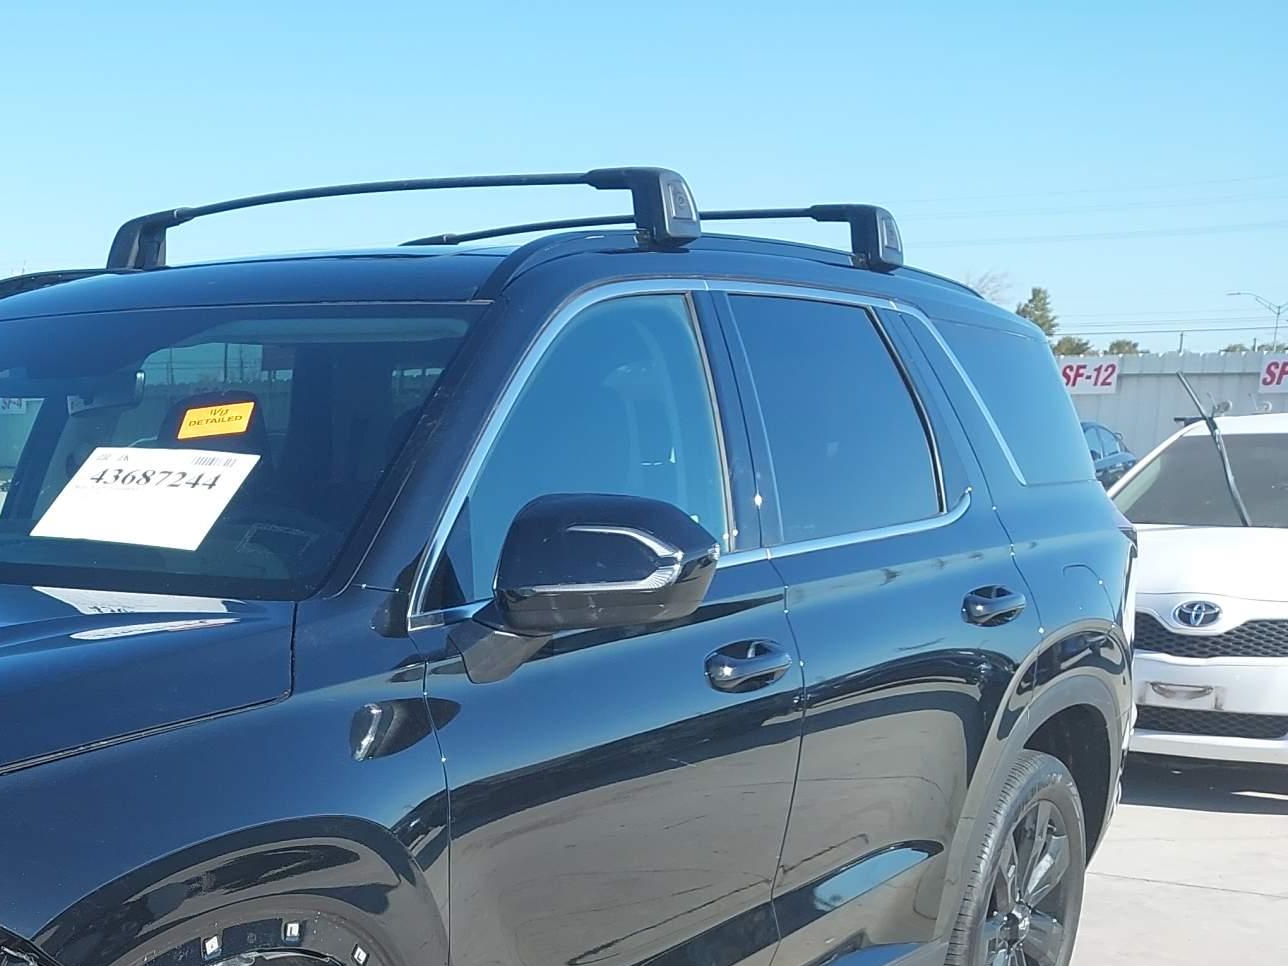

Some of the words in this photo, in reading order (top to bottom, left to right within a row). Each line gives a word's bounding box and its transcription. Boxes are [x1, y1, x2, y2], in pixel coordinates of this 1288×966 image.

[1062, 363, 1117, 387] SF-12
[188, 415, 243, 426] DETAILED
[90, 468, 222, 490] 43687244
